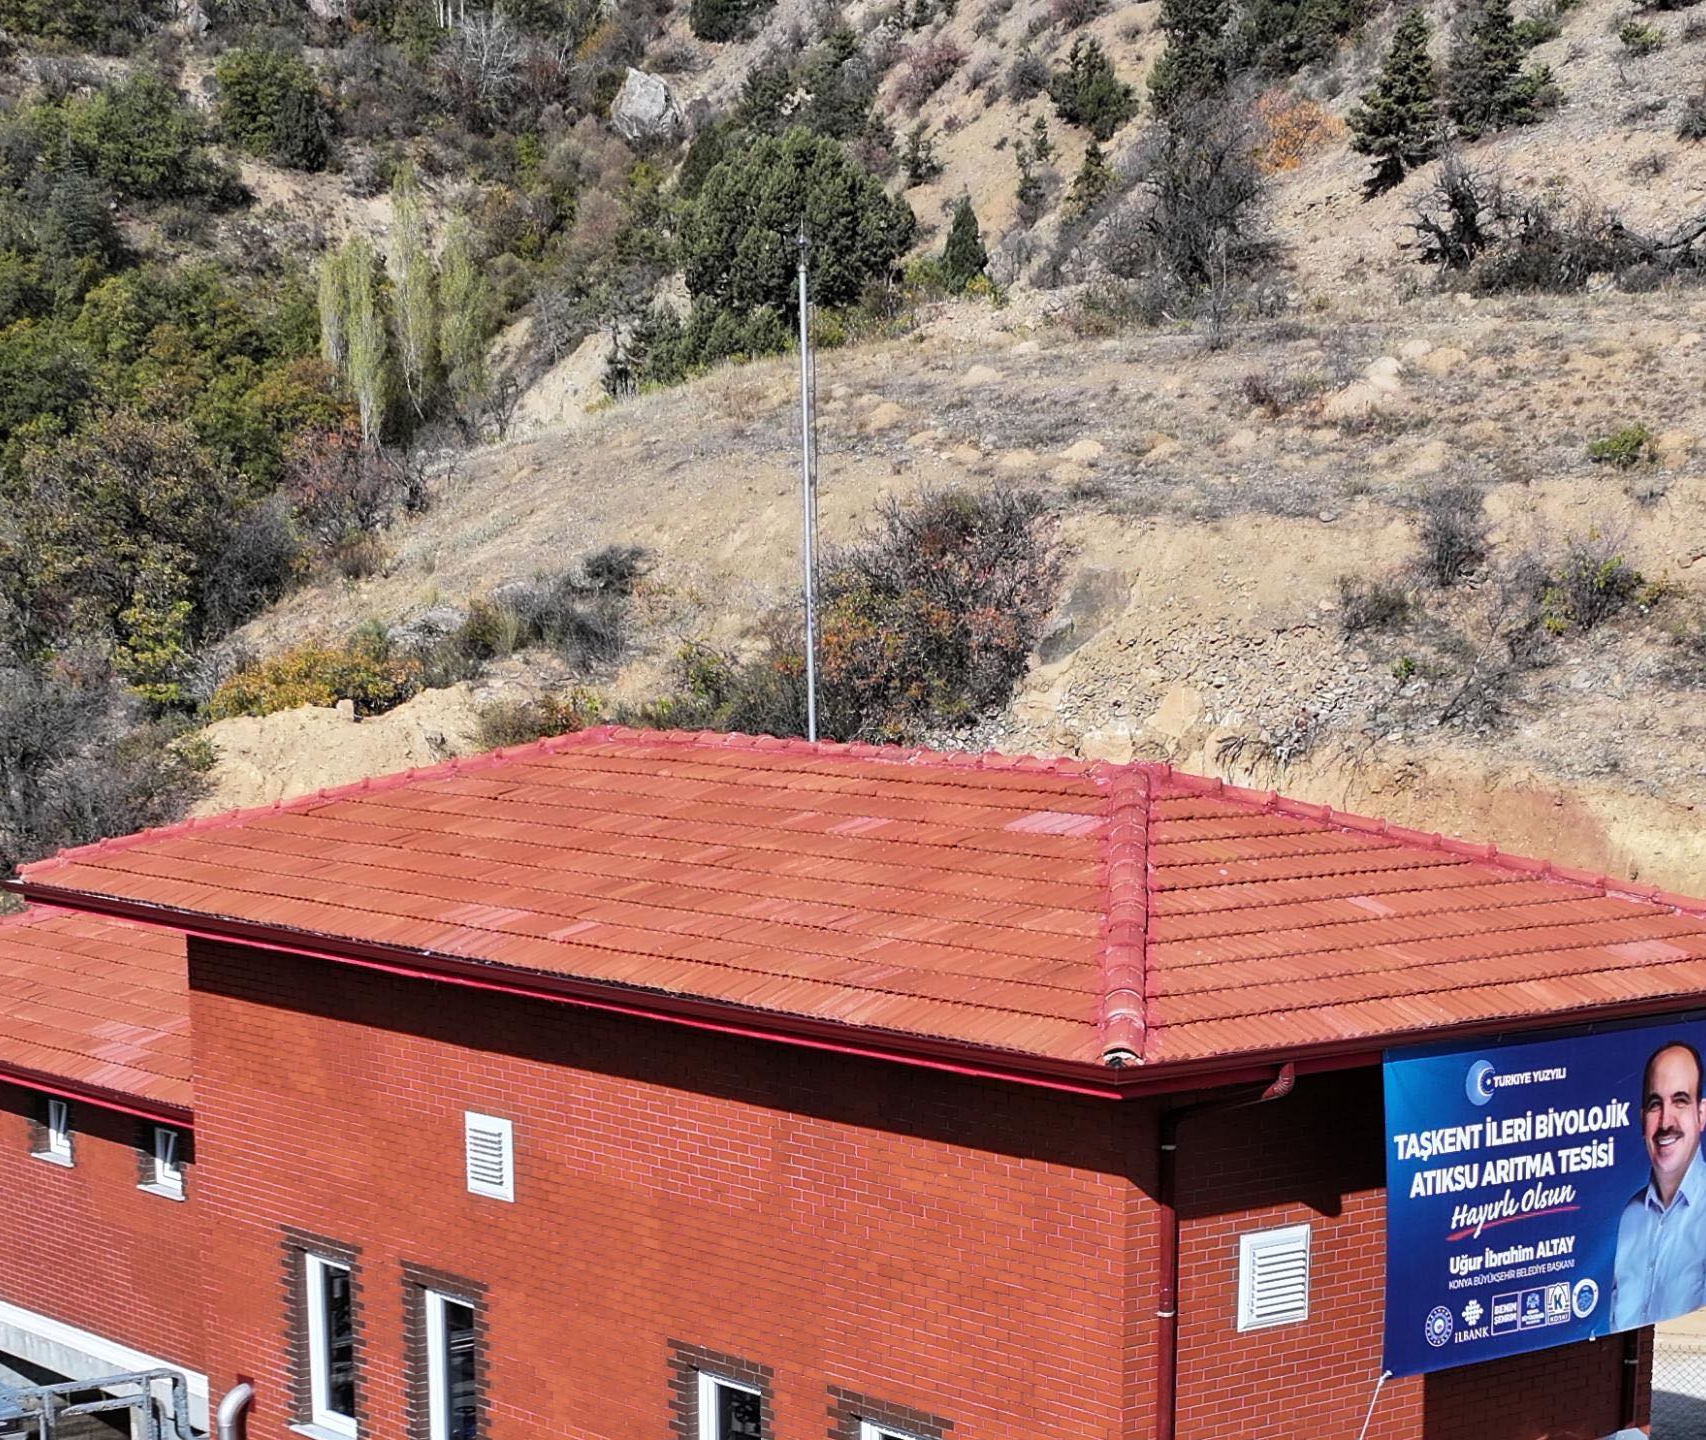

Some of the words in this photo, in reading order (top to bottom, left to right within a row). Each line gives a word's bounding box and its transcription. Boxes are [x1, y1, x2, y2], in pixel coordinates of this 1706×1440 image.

[1394, 1123, 1484, 1162] TAŞKENT
[1486, 1110, 1532, 1147] İLERİ
[1535, 1099, 1630, 1139] BİYOLOJİK
[1410, 1164, 1479, 1198] ATIKSU
[1481, 1151, 1556, 1187] ARITMA
[1558, 1137, 1614, 1174] TESİSİ
[1451, 1189, 1519, 1239] Hayırlı
[1521, 1182, 1576, 1212] Olsun
[1449, 1254, 1483, 1276] Uğur
[1485, 1245, 1534, 1268] İbrahim
[1536, 1235, 1575, 1259] ALTAY
[1449, 1274, 1472, 1290] KONYA
[1473, 1268, 1516, 1287] BÜYÜKŞEHİR
[1516, 1264, 1547, 1280] BELEDİYE
[1547, 1259, 1575, 1273] BAŞKANI
